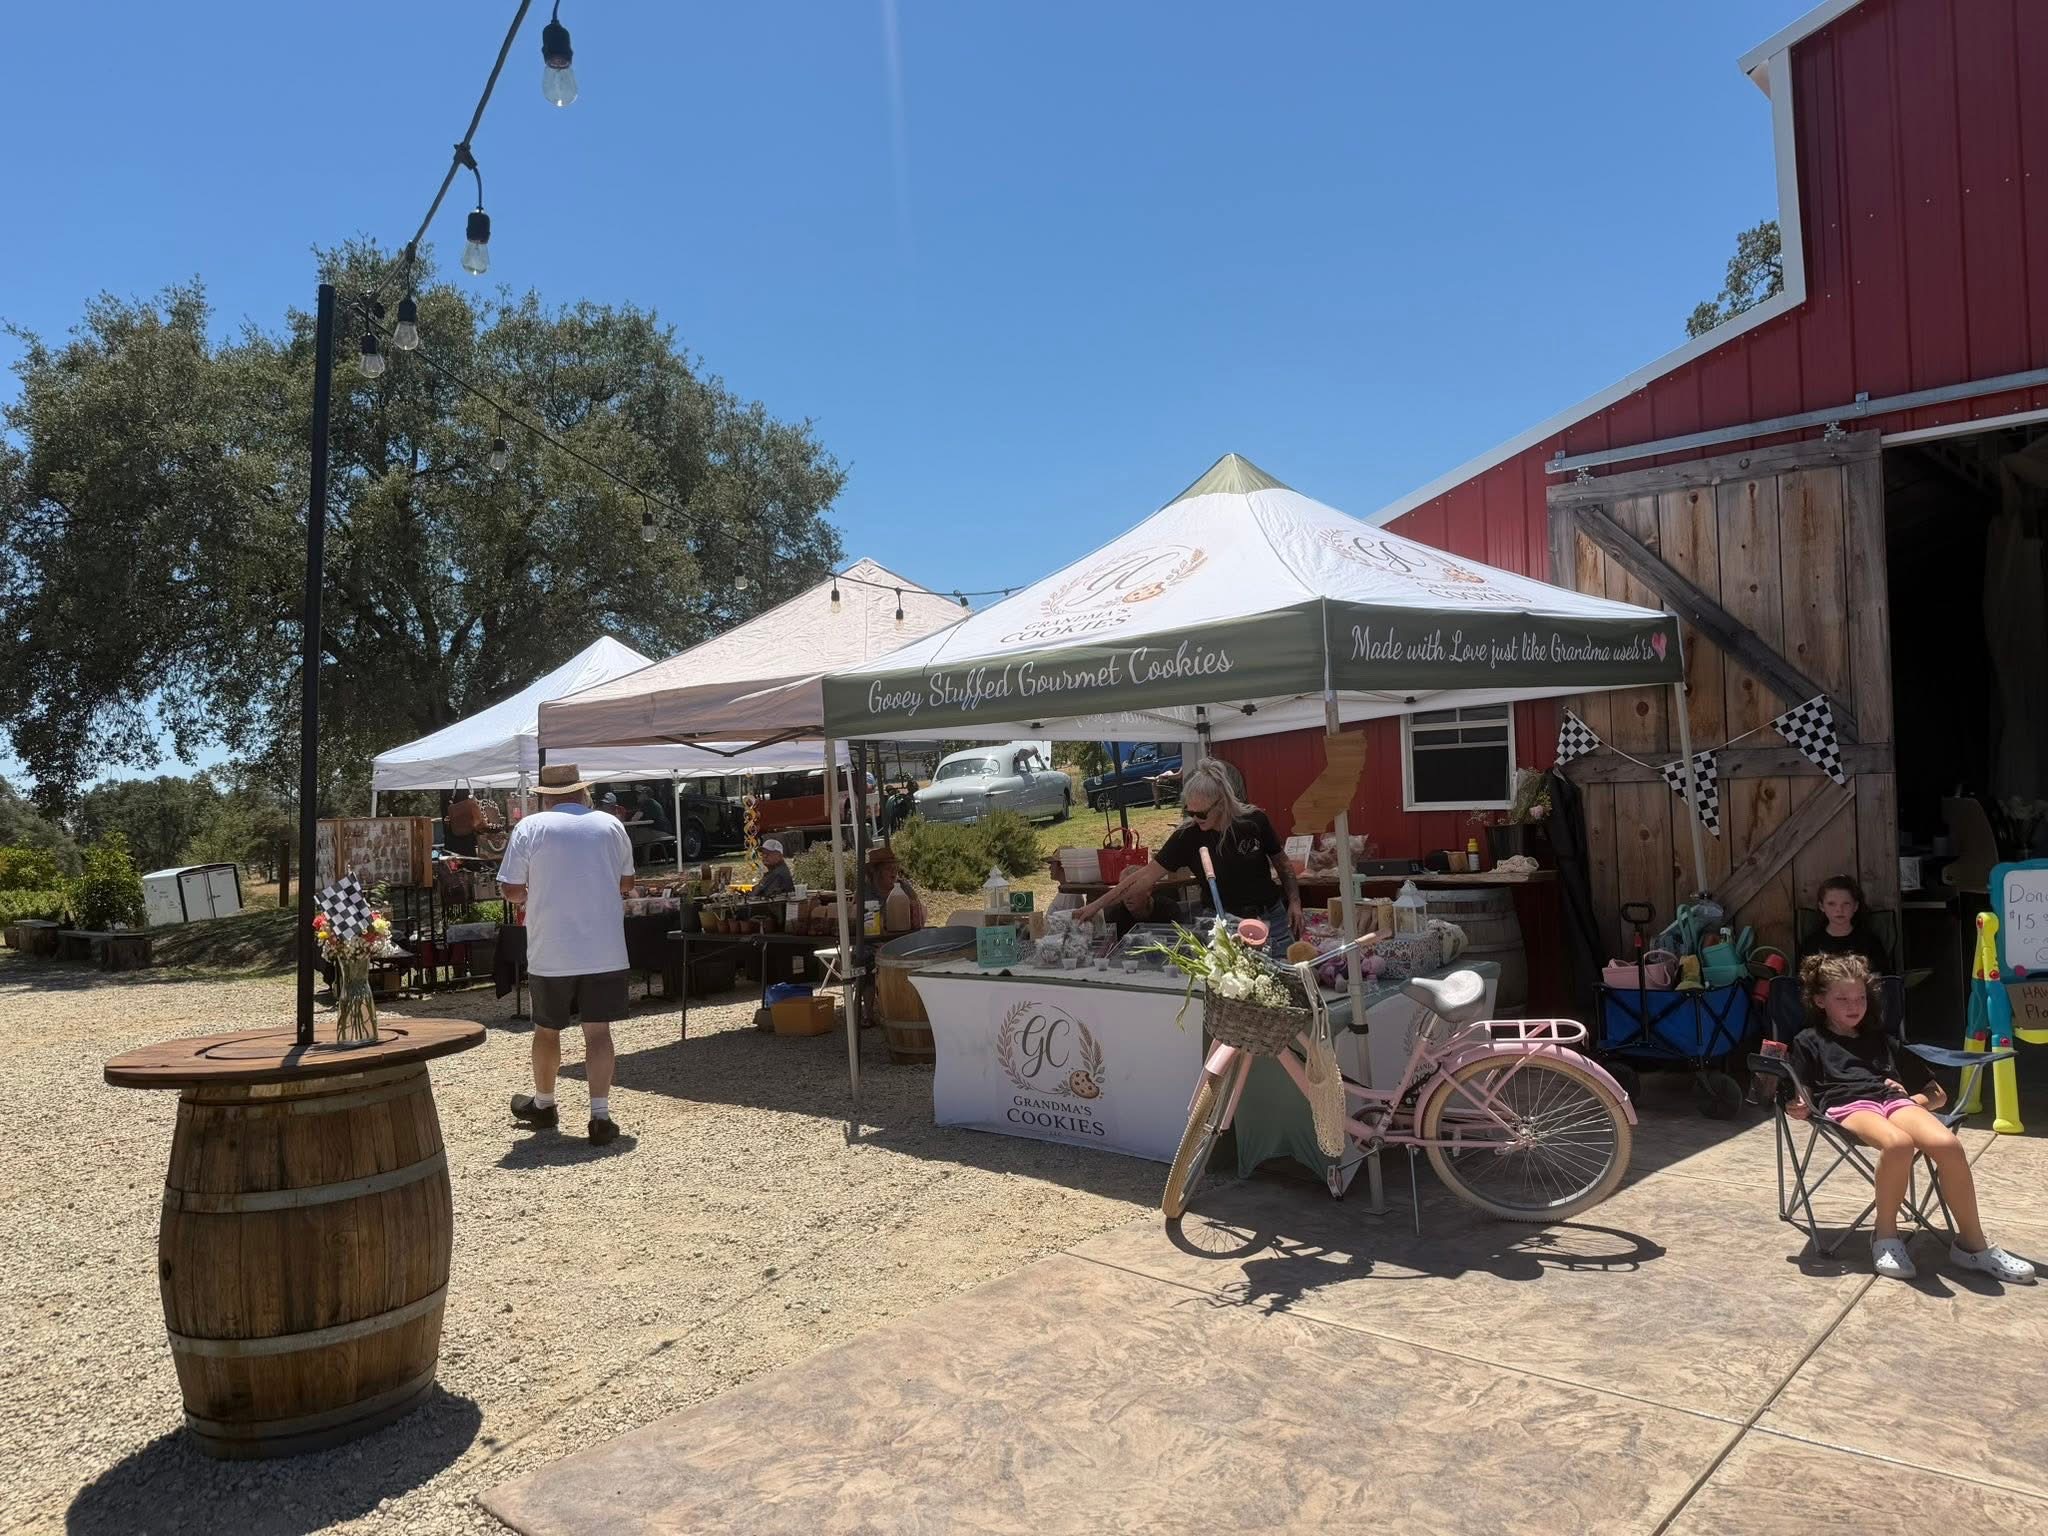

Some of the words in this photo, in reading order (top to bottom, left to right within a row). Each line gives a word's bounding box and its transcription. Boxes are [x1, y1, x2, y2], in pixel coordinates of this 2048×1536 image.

[1000, 614, 1131, 643] COOKIES
[1024, 607, 1131, 630] GRANDMA'S
[1351, 625, 1403, 661] Made
[1407, 629, 1447, 662] with
[1450, 629, 1488, 663] Love
[1490, 635, 1519, 669] just
[1522, 631, 1548, 662] like
[1550, 632, 1610, 663] Grandma
[1613, 633, 1642, 662] used
[868, 680, 924, 716] Gooey
[929, 667, 1013, 711] Stuffed
[1018, 655, 1123, 697] Gourmet
[1129, 640, 1234, 685] Cookies
[2009, 884, 2048, 904] Don
[1014, 1014, 1070, 1078] GC
[1013, 1095, 1092, 1117] GRANDMA'S
[1007, 1108, 1105, 1136] COOKIES
